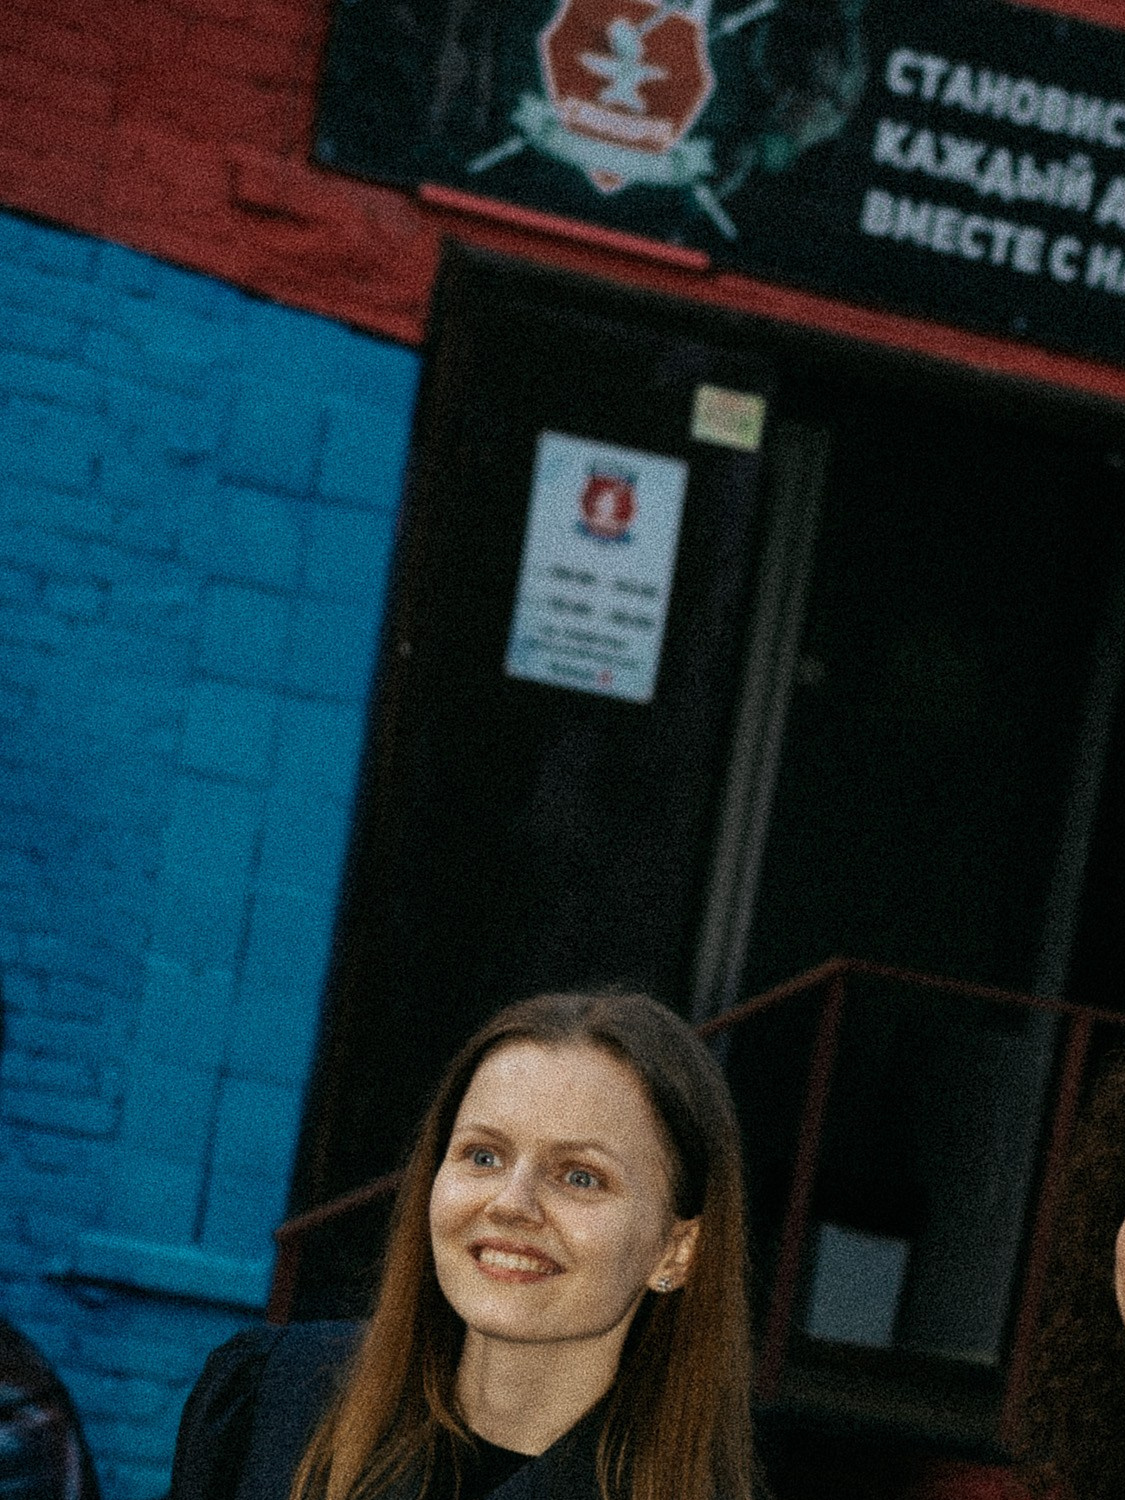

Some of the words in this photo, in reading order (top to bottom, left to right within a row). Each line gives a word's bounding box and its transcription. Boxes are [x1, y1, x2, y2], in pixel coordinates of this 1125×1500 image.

[874, 120, 1096, 211] КАЖДЫЙ
[862, 190, 1045, 273] ВМЕСТЕ
[1050, 236, 1080, 281] С
